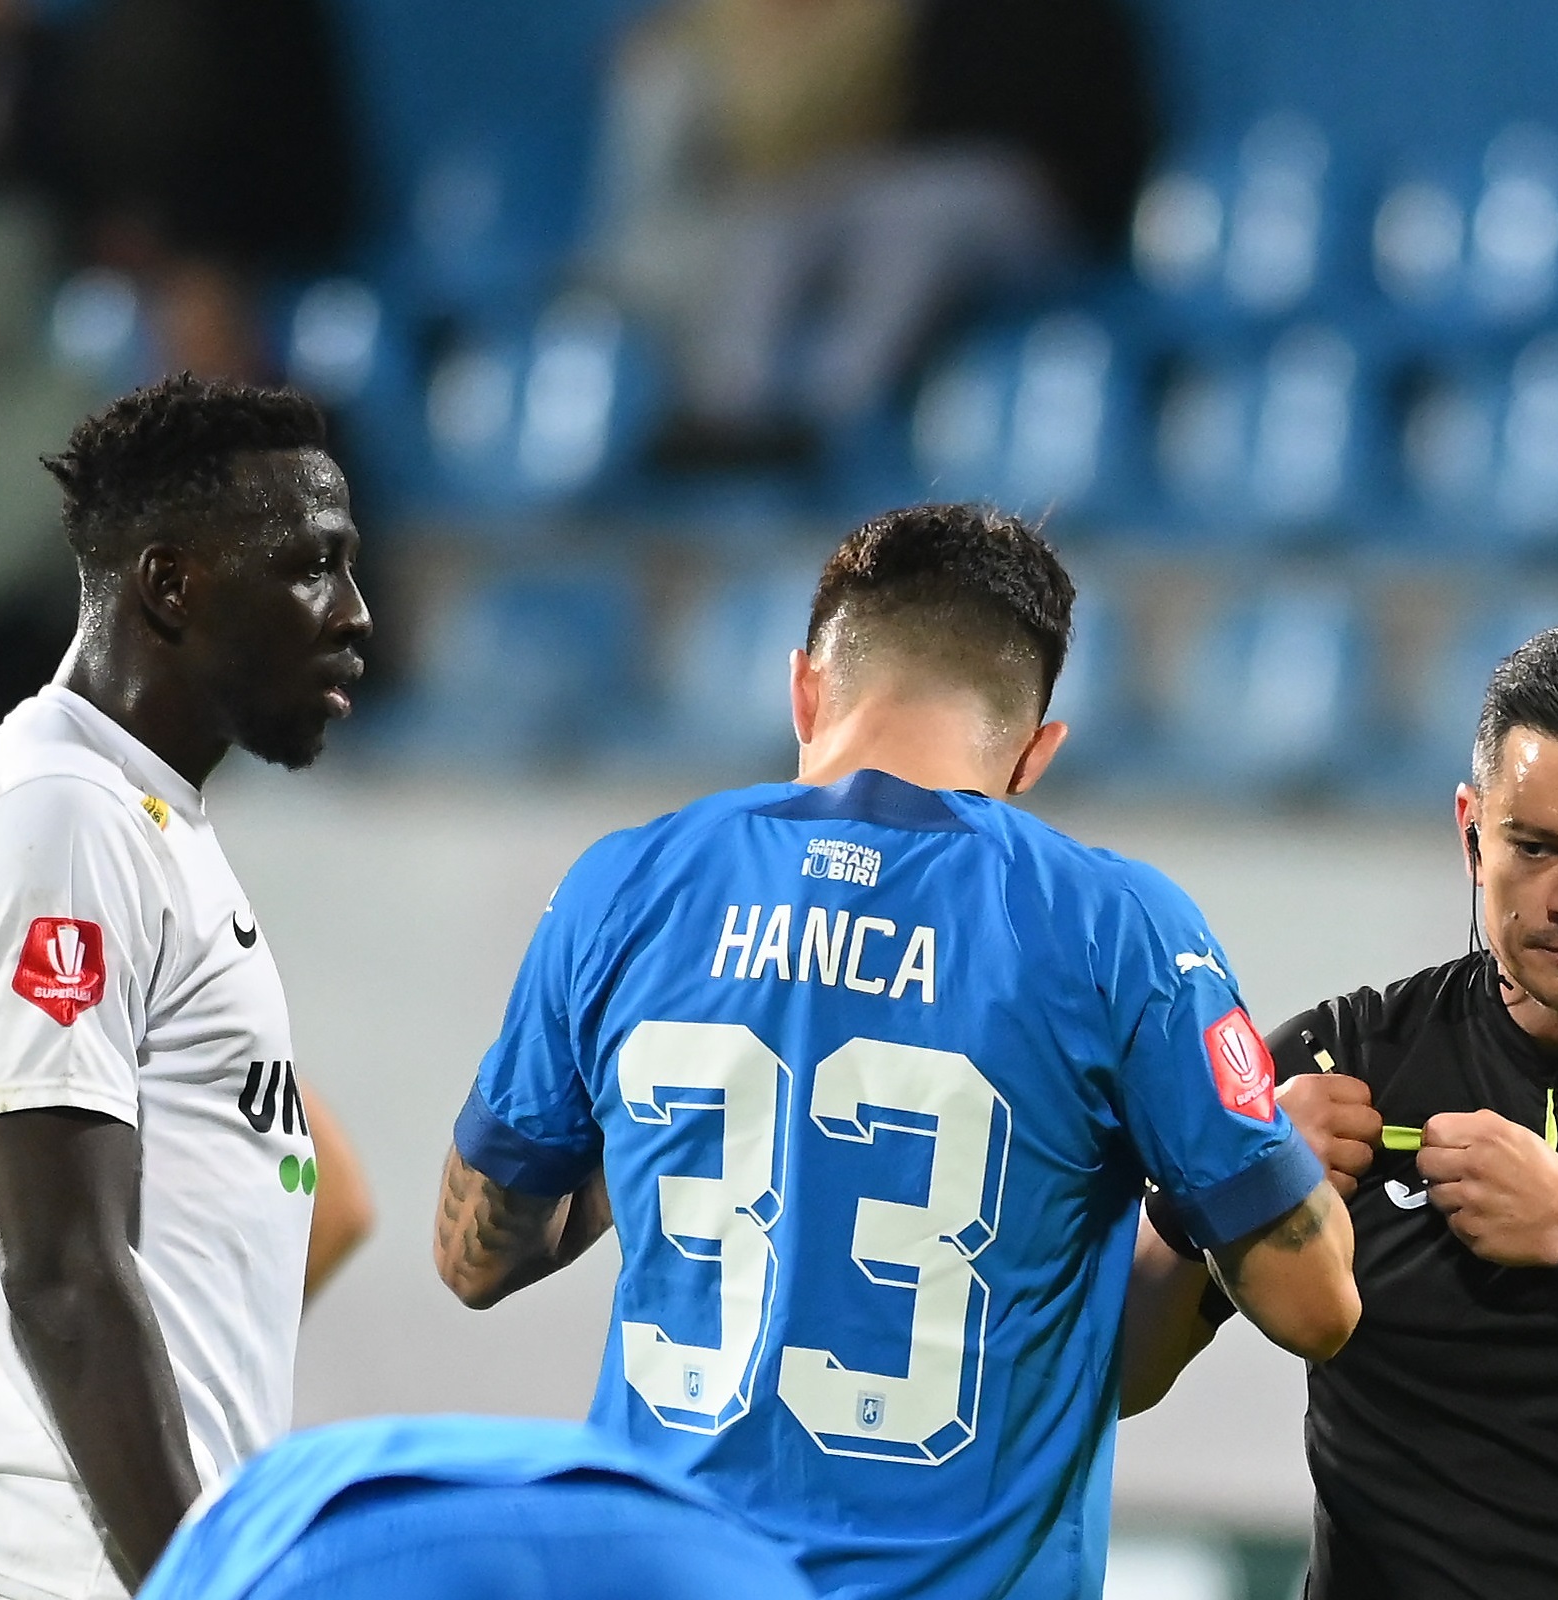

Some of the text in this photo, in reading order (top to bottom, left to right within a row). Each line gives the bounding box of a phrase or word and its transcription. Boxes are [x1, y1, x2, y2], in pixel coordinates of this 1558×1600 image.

[809, 838, 882, 861] CAMPIOANA
[832, 848, 881, 873] MARI
[801, 853, 879, 888] IUBIRI
[710, 904, 936, 1003] HANCA
[617, 1020, 1012, 1466] 33
